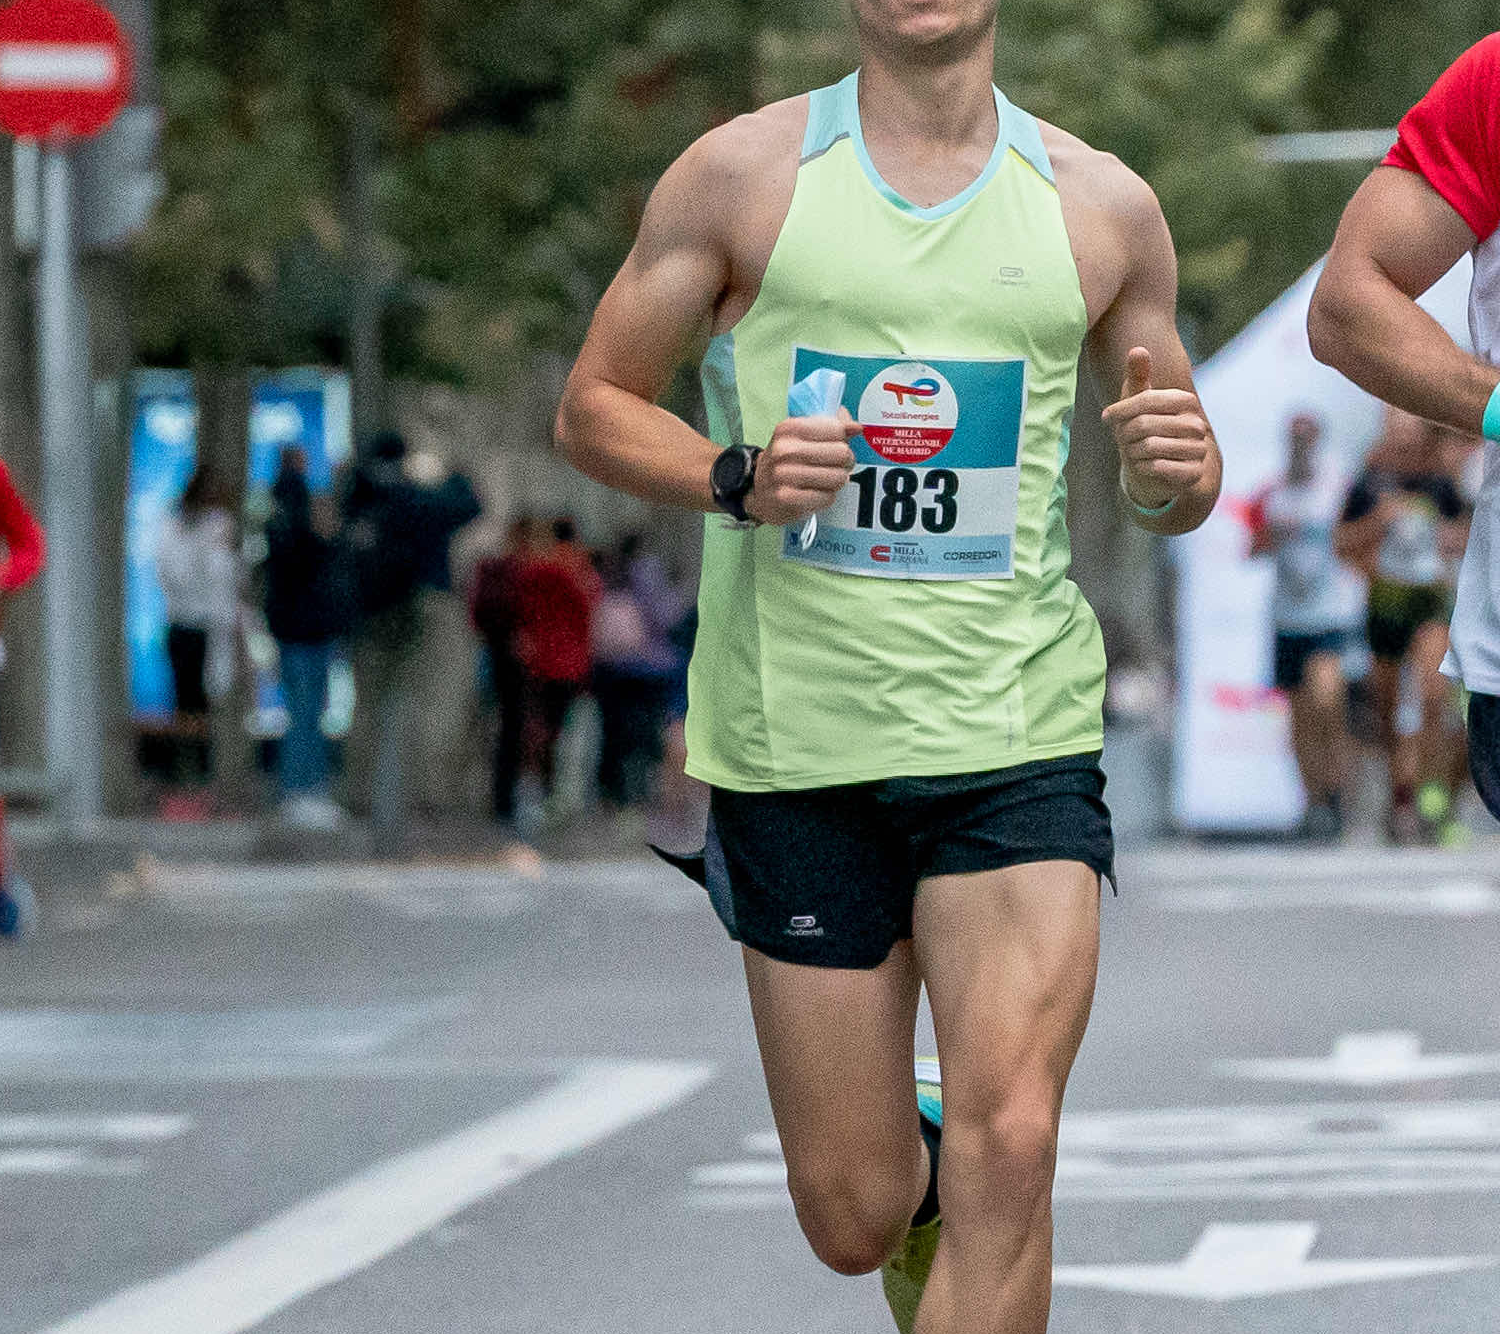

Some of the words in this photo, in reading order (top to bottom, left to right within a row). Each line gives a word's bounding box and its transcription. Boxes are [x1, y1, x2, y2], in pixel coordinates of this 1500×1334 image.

[881, 410, 940, 422] TotalEnergies
[894, 429, 922, 438] MILLA
[849, 466, 959, 534] 183
